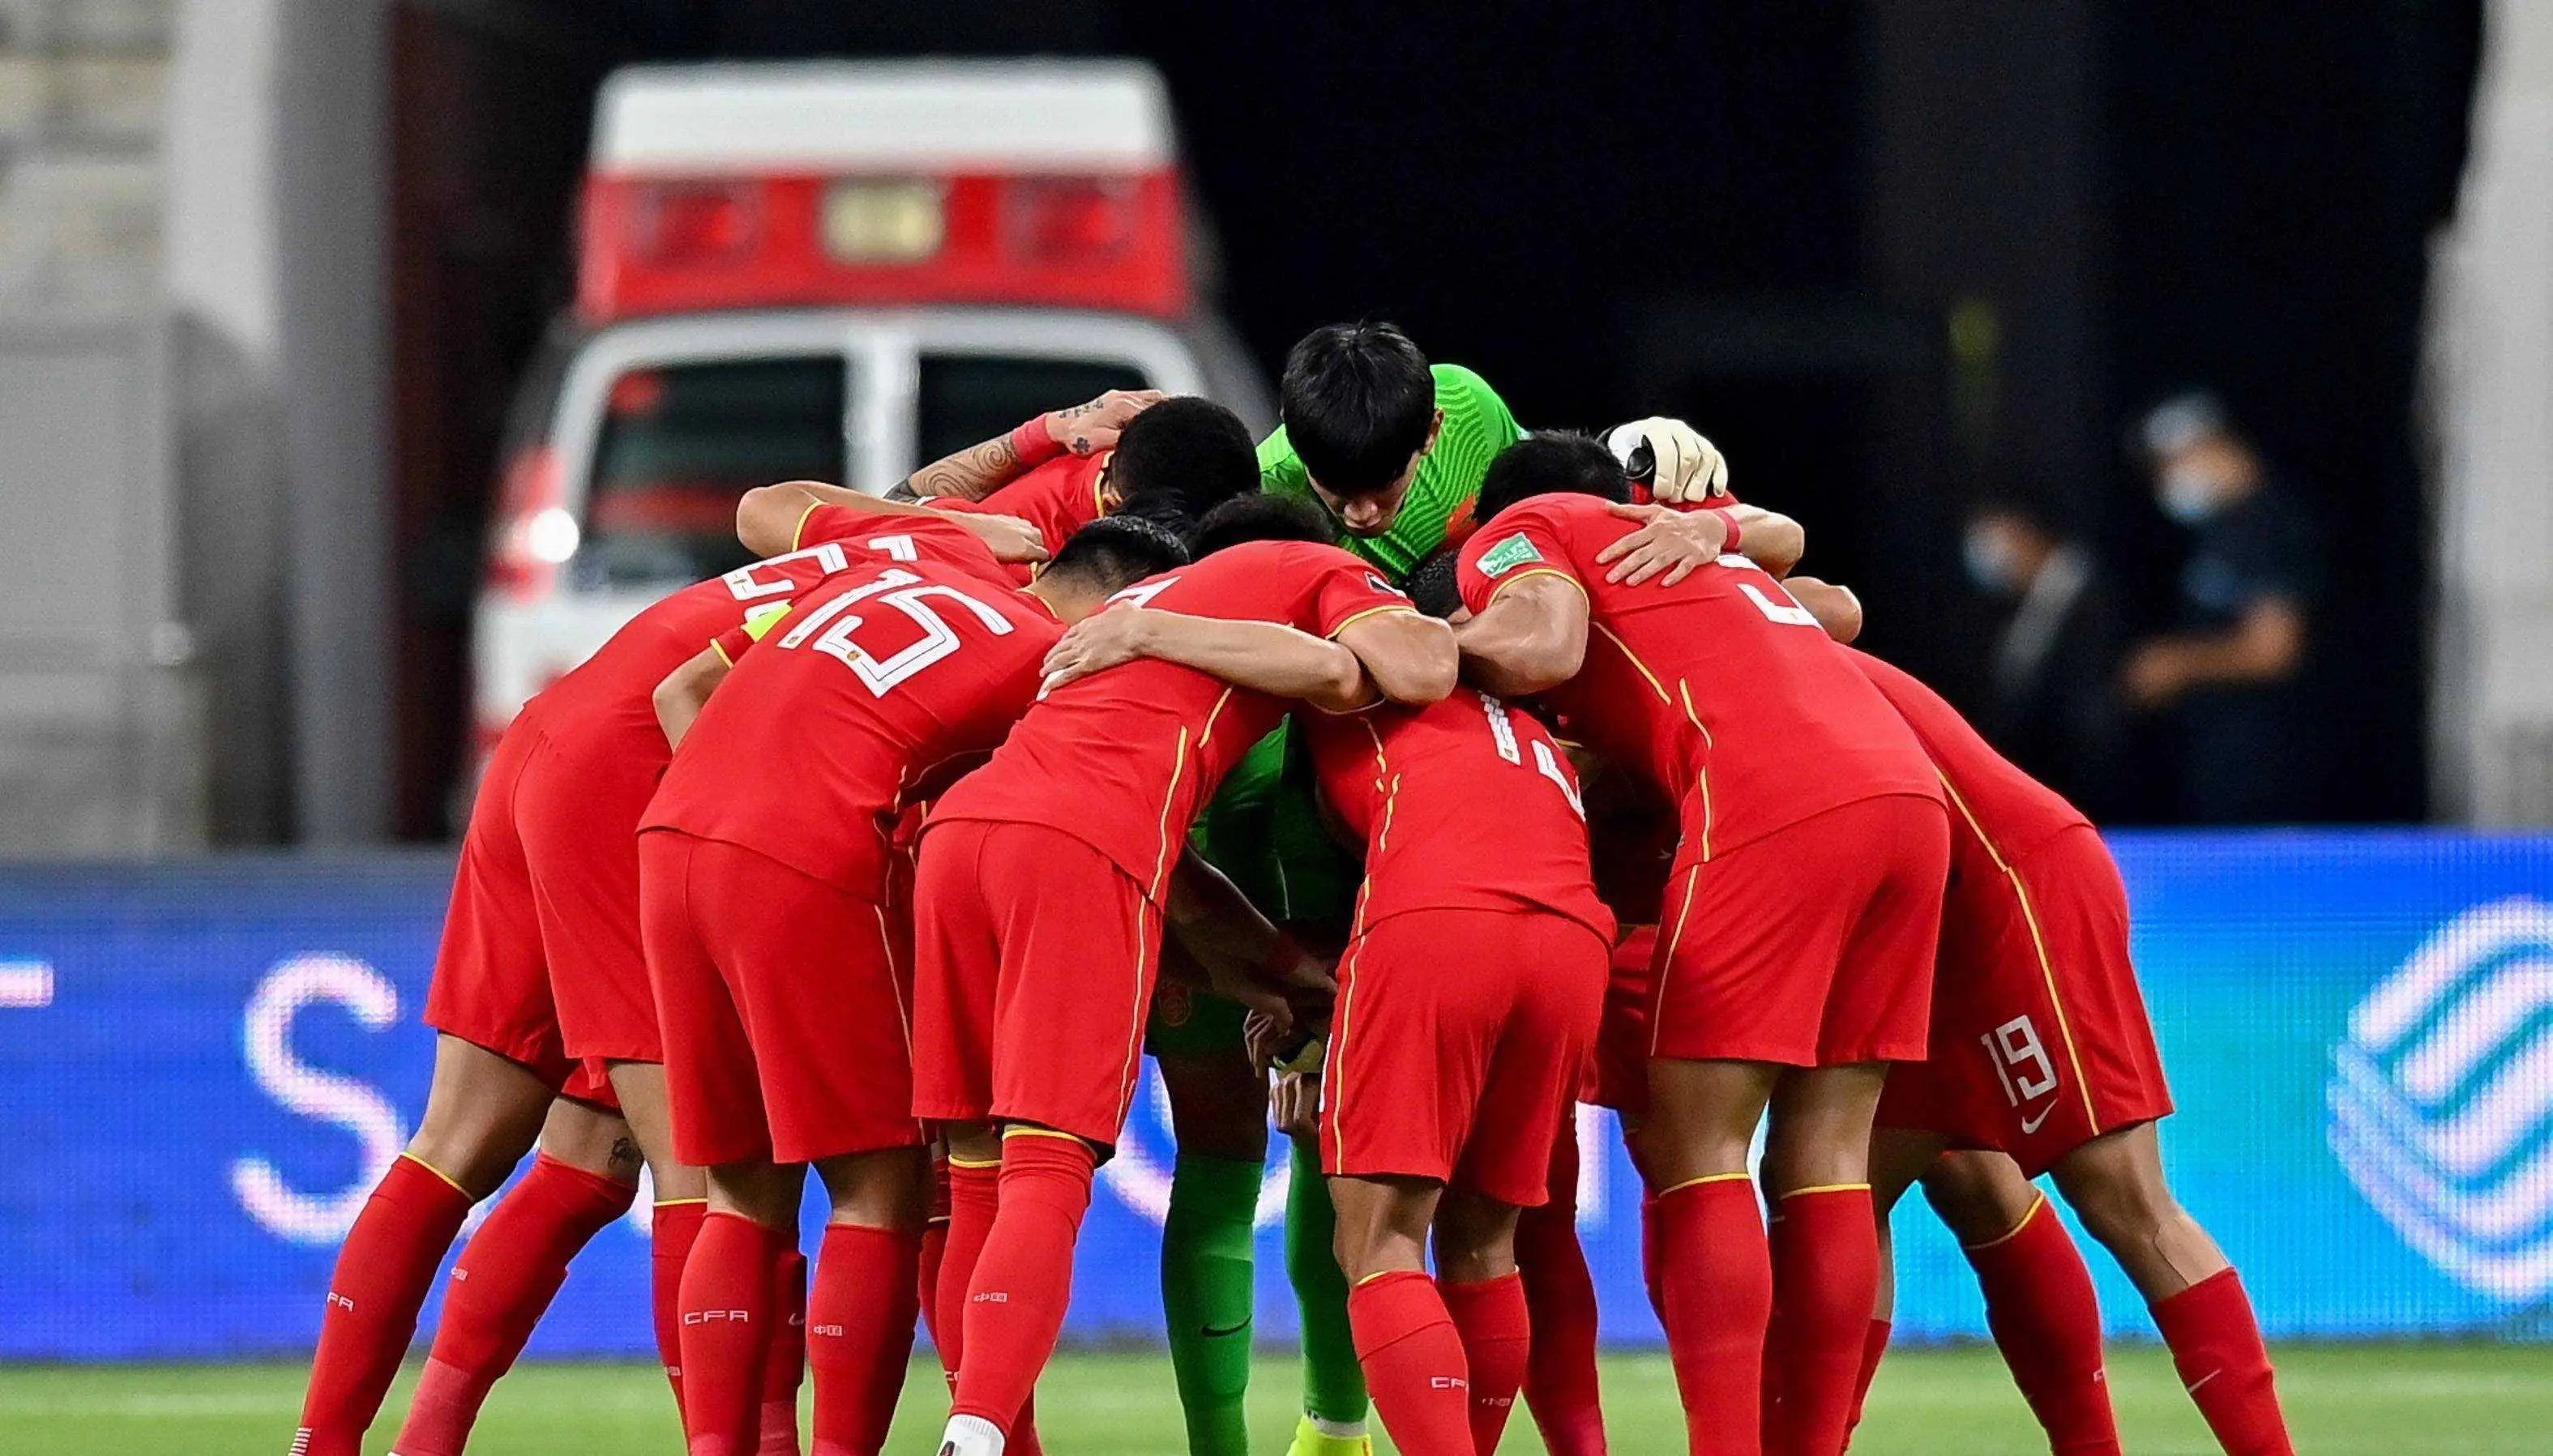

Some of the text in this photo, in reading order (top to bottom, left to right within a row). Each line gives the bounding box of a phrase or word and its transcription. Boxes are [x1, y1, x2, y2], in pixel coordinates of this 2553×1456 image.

[777, 569, 1015, 698] 15
[1980, 1014, 2058, 1108] 19
[327, 1292, 354, 1313] FA
[684, 1309, 749, 1326] CFA
[1430, 1376, 1469, 1393] CF
